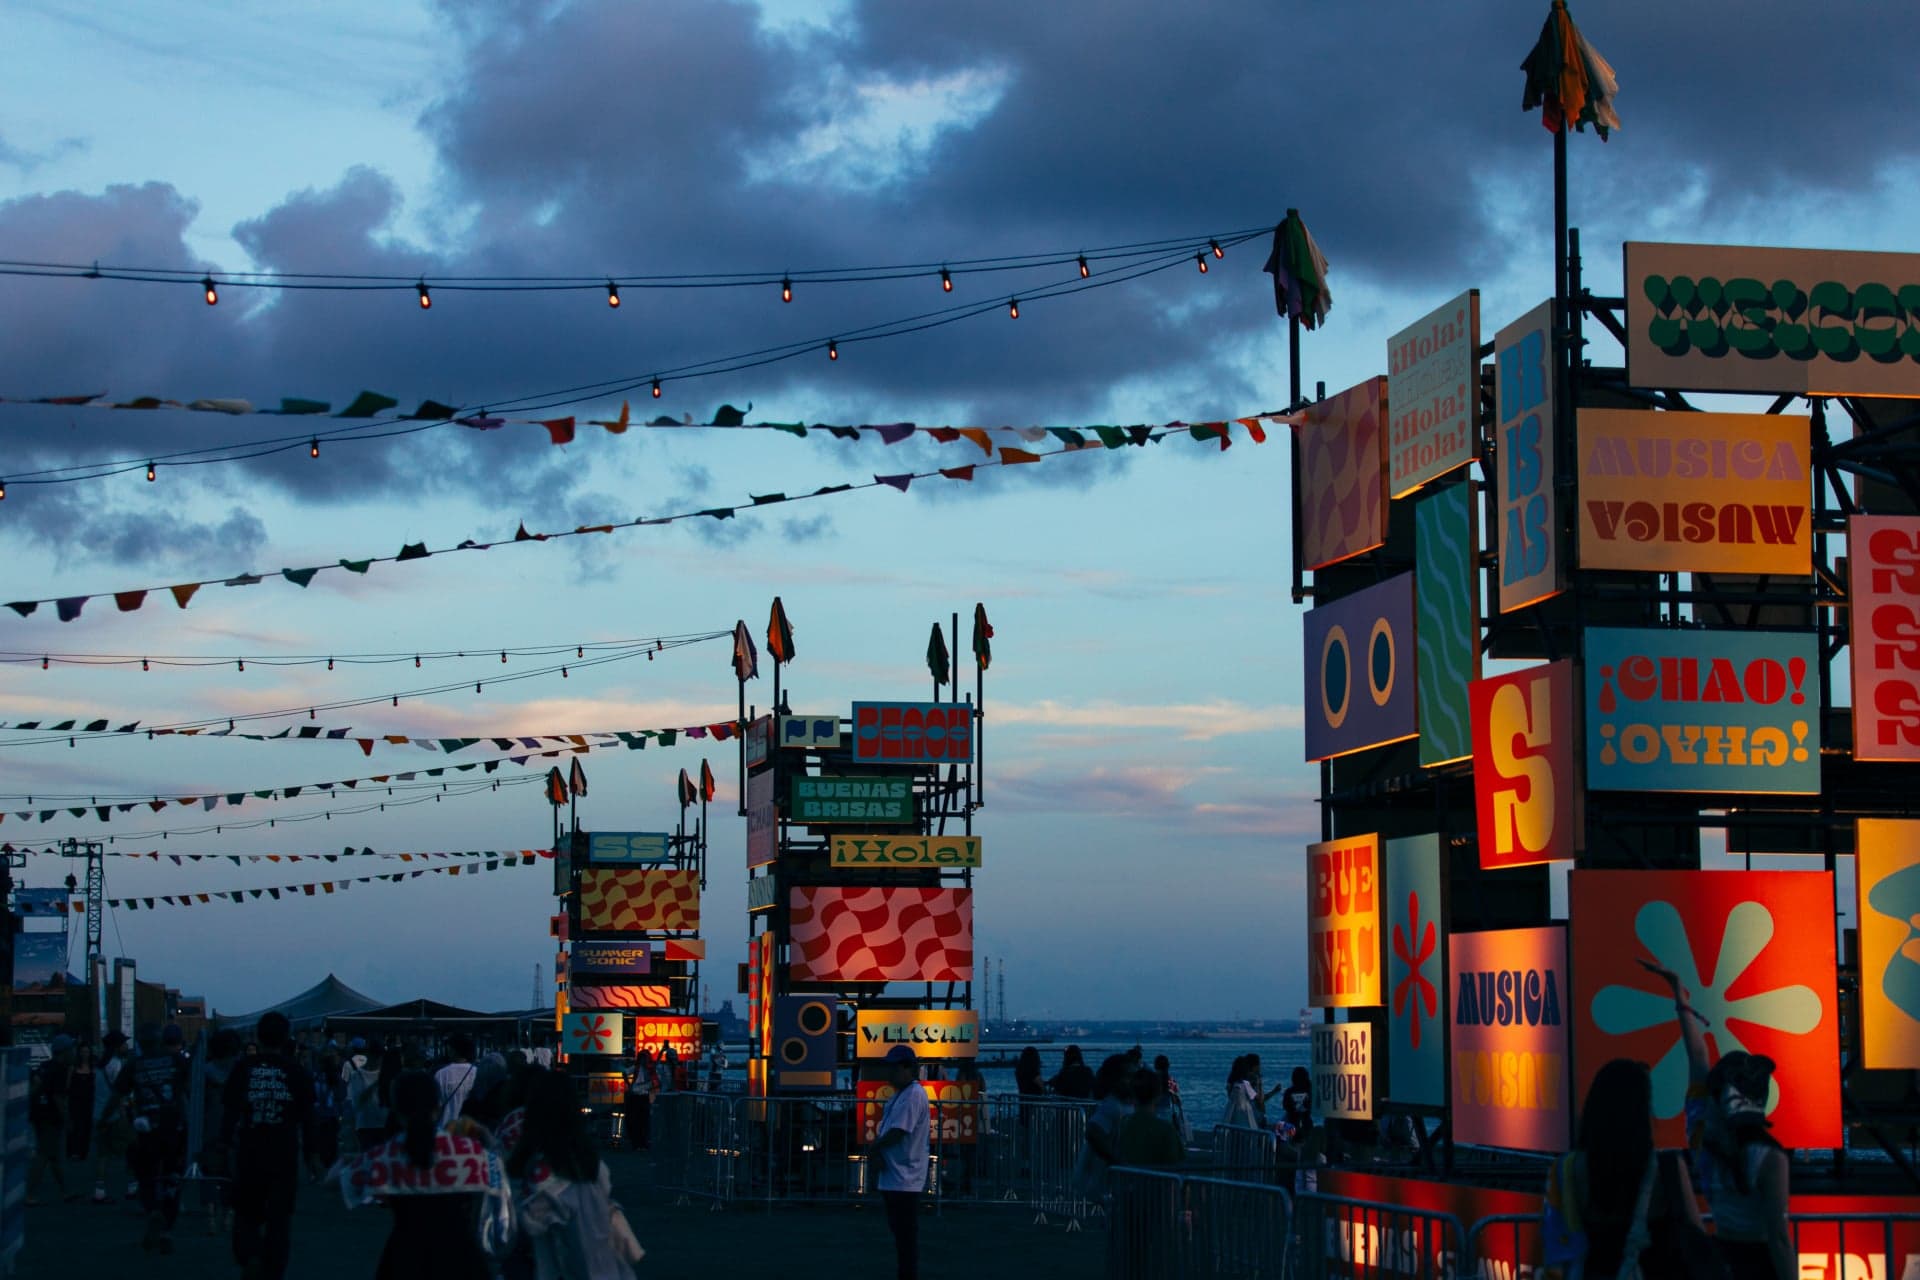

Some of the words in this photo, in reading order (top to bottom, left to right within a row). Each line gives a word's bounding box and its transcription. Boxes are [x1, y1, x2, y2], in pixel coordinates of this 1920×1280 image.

[1393, 309, 1464, 377] ¡Hola!
[1500, 329, 1547, 424] BR
[1394, 384, 1465, 446] ¡Hola!
[1395, 419, 1465, 481] ¡Hola!
[1506, 413, 1542, 502] IS
[1586, 438, 1803, 481] MUSICA
[1504, 495, 1548, 587] AS
[1588, 501, 1804, 544] MUSICA
[1600, 657, 1807, 713] ¡CHAO!
[858, 708, 971, 758] BEACH
[1600, 721, 1809, 766] ¡CHAO!
[1490, 677, 1555, 855] S
[798, 782, 906, 798] BUENAS
[803, 801, 902, 818] BRISAS
[592, 836, 665, 859] SS
[837, 840, 976, 863] ¡Hola!
[1312, 846, 1373, 918] BUE
[577, 949, 645, 958] SUMMER
[584, 957, 637, 966] SONIC
[1456, 970, 1561, 1026] MUSICA
[861, 1022, 975, 1043] WELCOME
[1315, 1031, 1366, 1065] ¡Hola!
[1316, 1074, 1367, 1113] ¡Hola!
[1458, 1050, 1561, 1110] MUSICA
